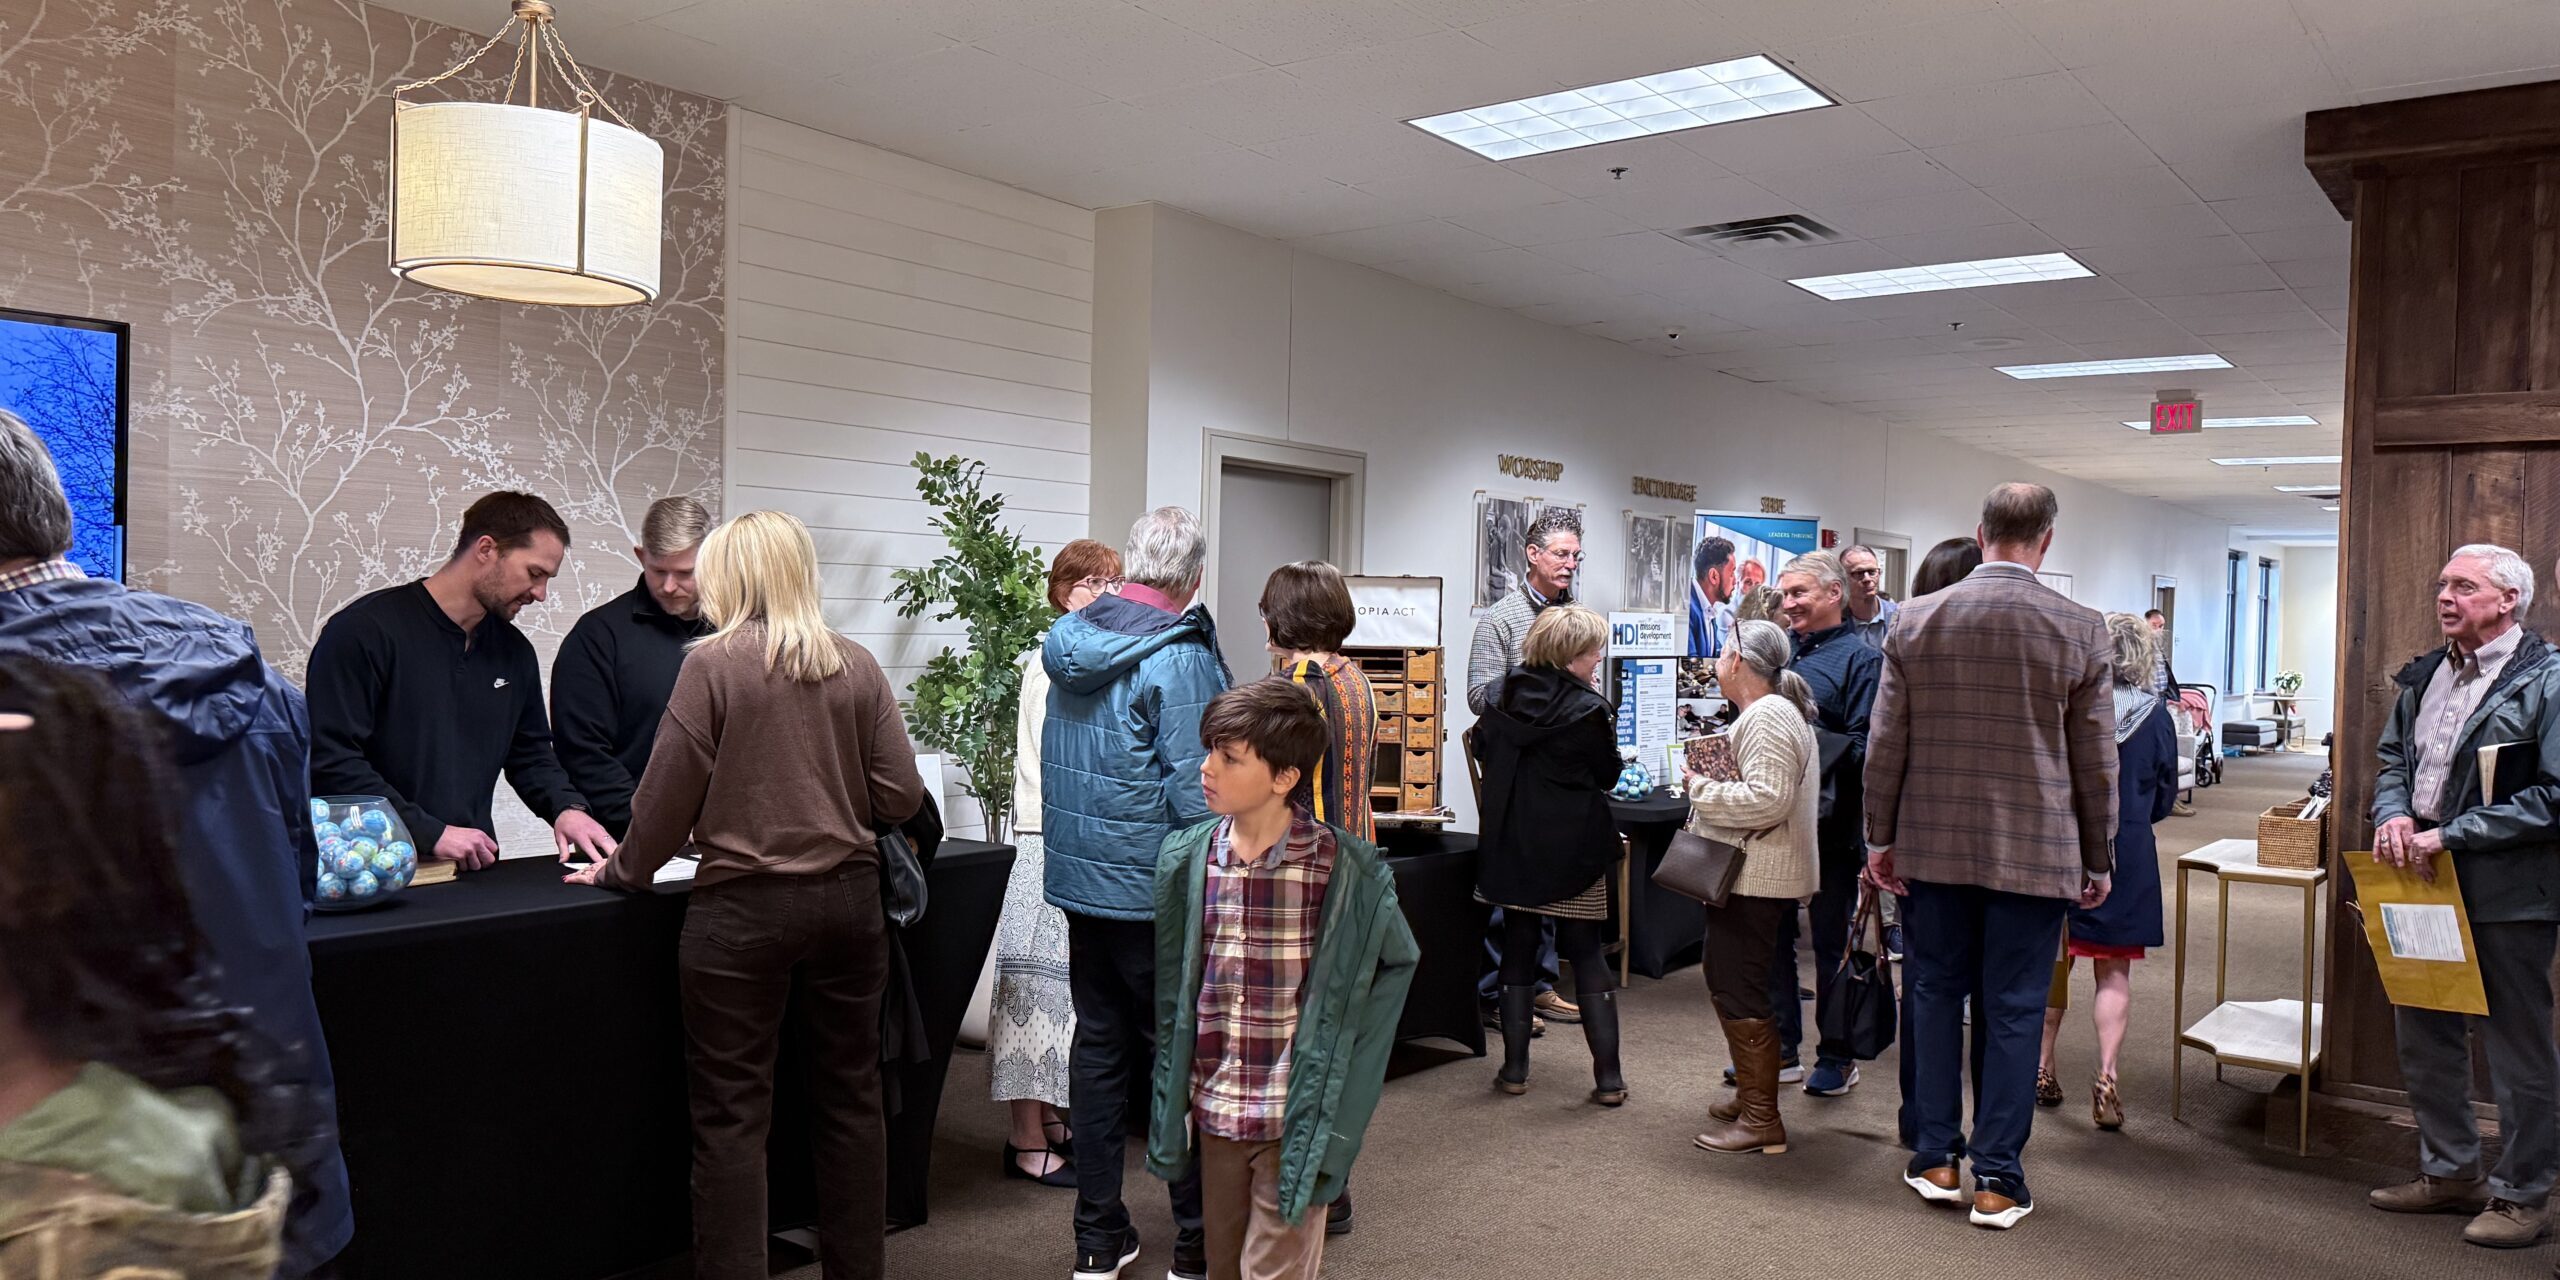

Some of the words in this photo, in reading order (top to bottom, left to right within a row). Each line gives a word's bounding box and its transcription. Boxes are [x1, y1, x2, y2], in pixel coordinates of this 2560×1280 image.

[2156, 403, 2196, 431] EXIT
[1498, 454, 1564, 483] WORSHIP
[1632, 476, 1698, 502] ENCOURAGE
[1357, 606, 1389, 616] OPIA
[1393, 607, 1415, 616] ACT
[1612, 623, 1639, 646] MDI
[1639, 623, 1661, 631] missions
[1639, 632, 1672, 641] development
